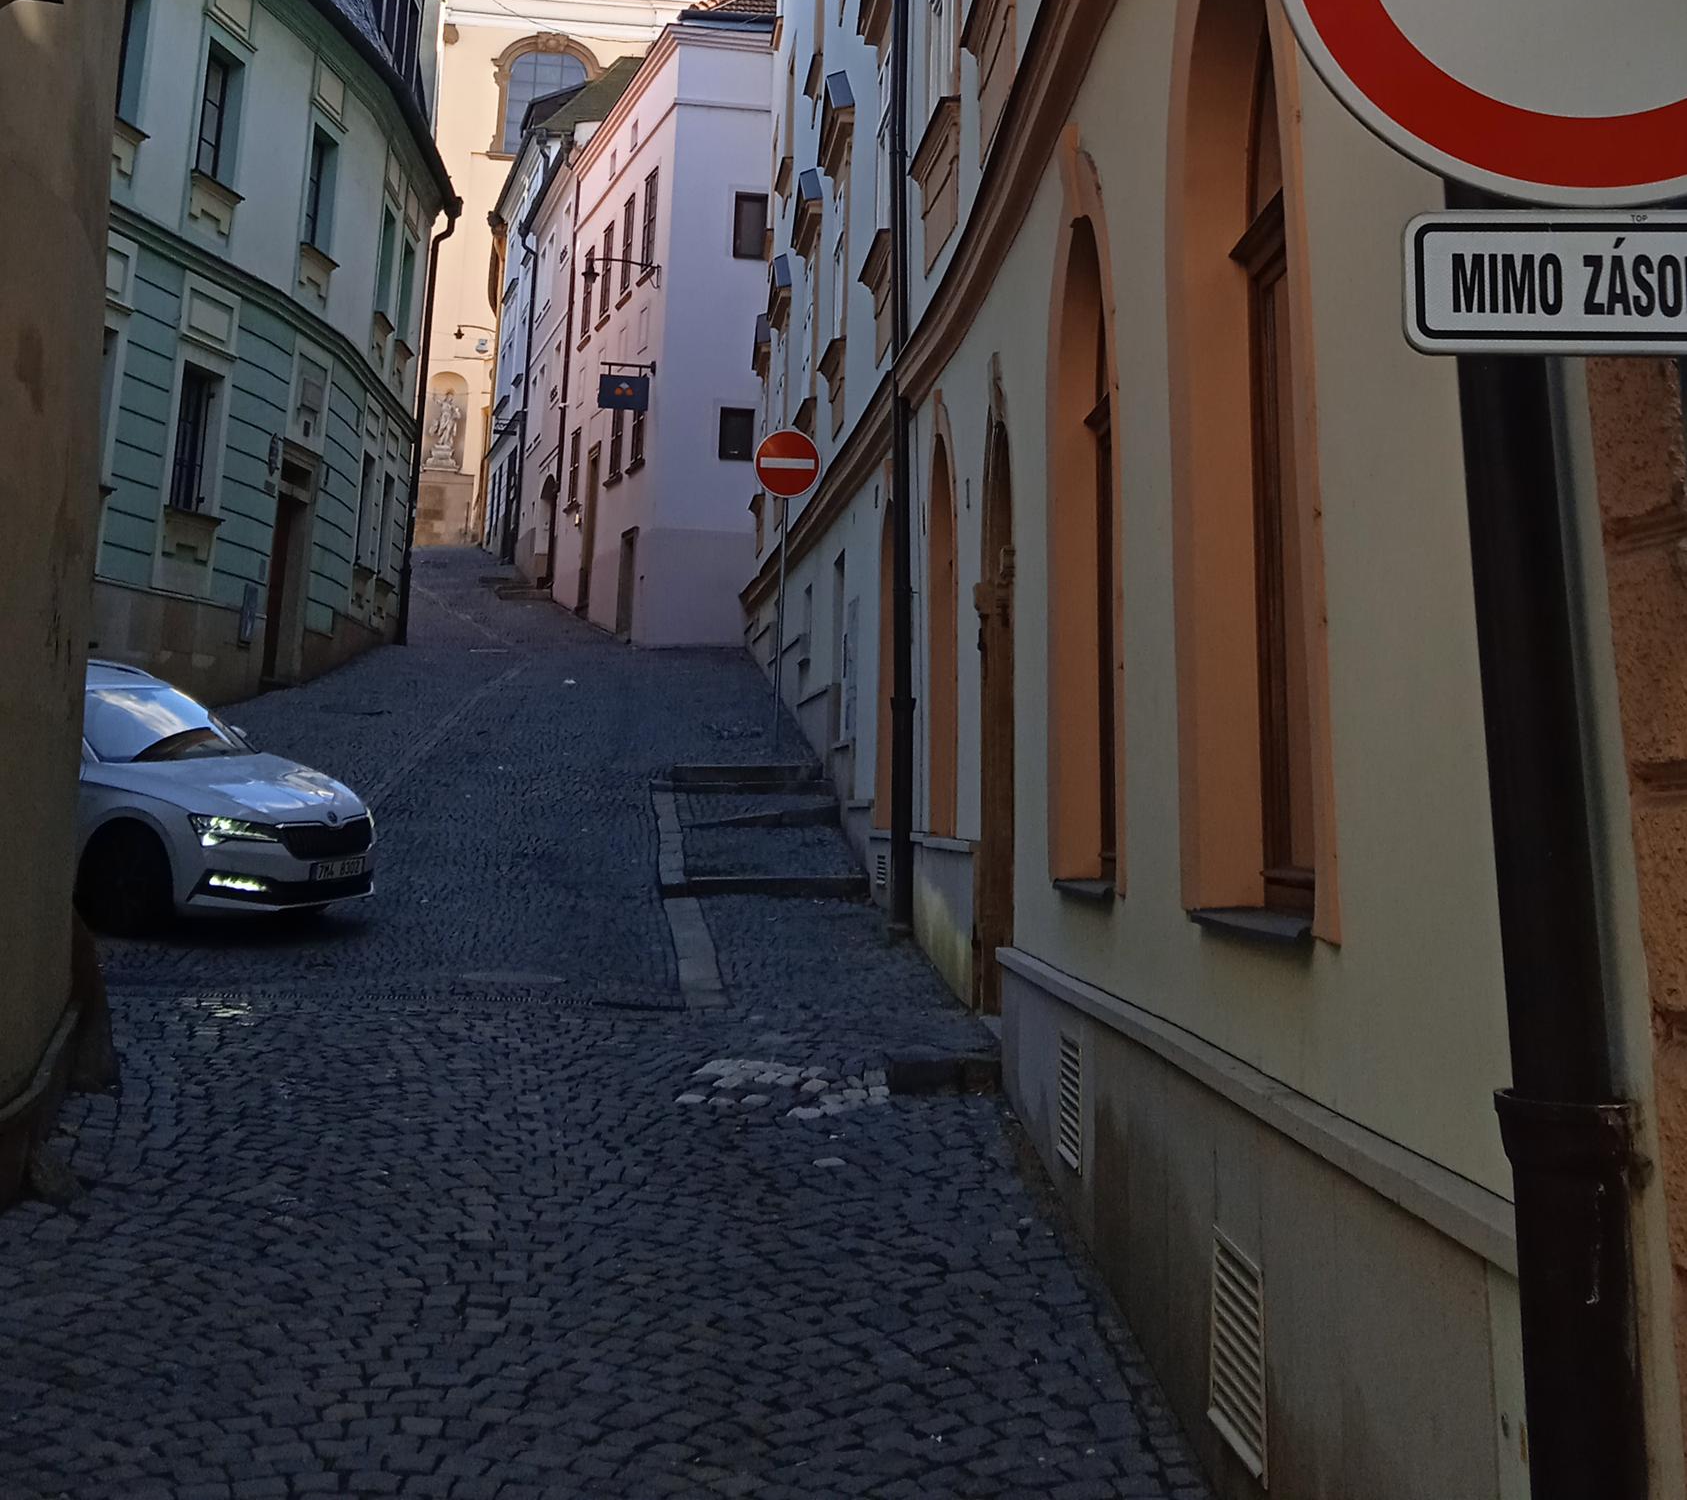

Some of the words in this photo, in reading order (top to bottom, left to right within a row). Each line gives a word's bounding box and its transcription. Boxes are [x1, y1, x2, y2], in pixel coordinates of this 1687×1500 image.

[1629, 213, 1649, 223] TOP
[1451, 252, 1564, 317] MIMO
[1582, 236, 1687, 318] ZÁSO
